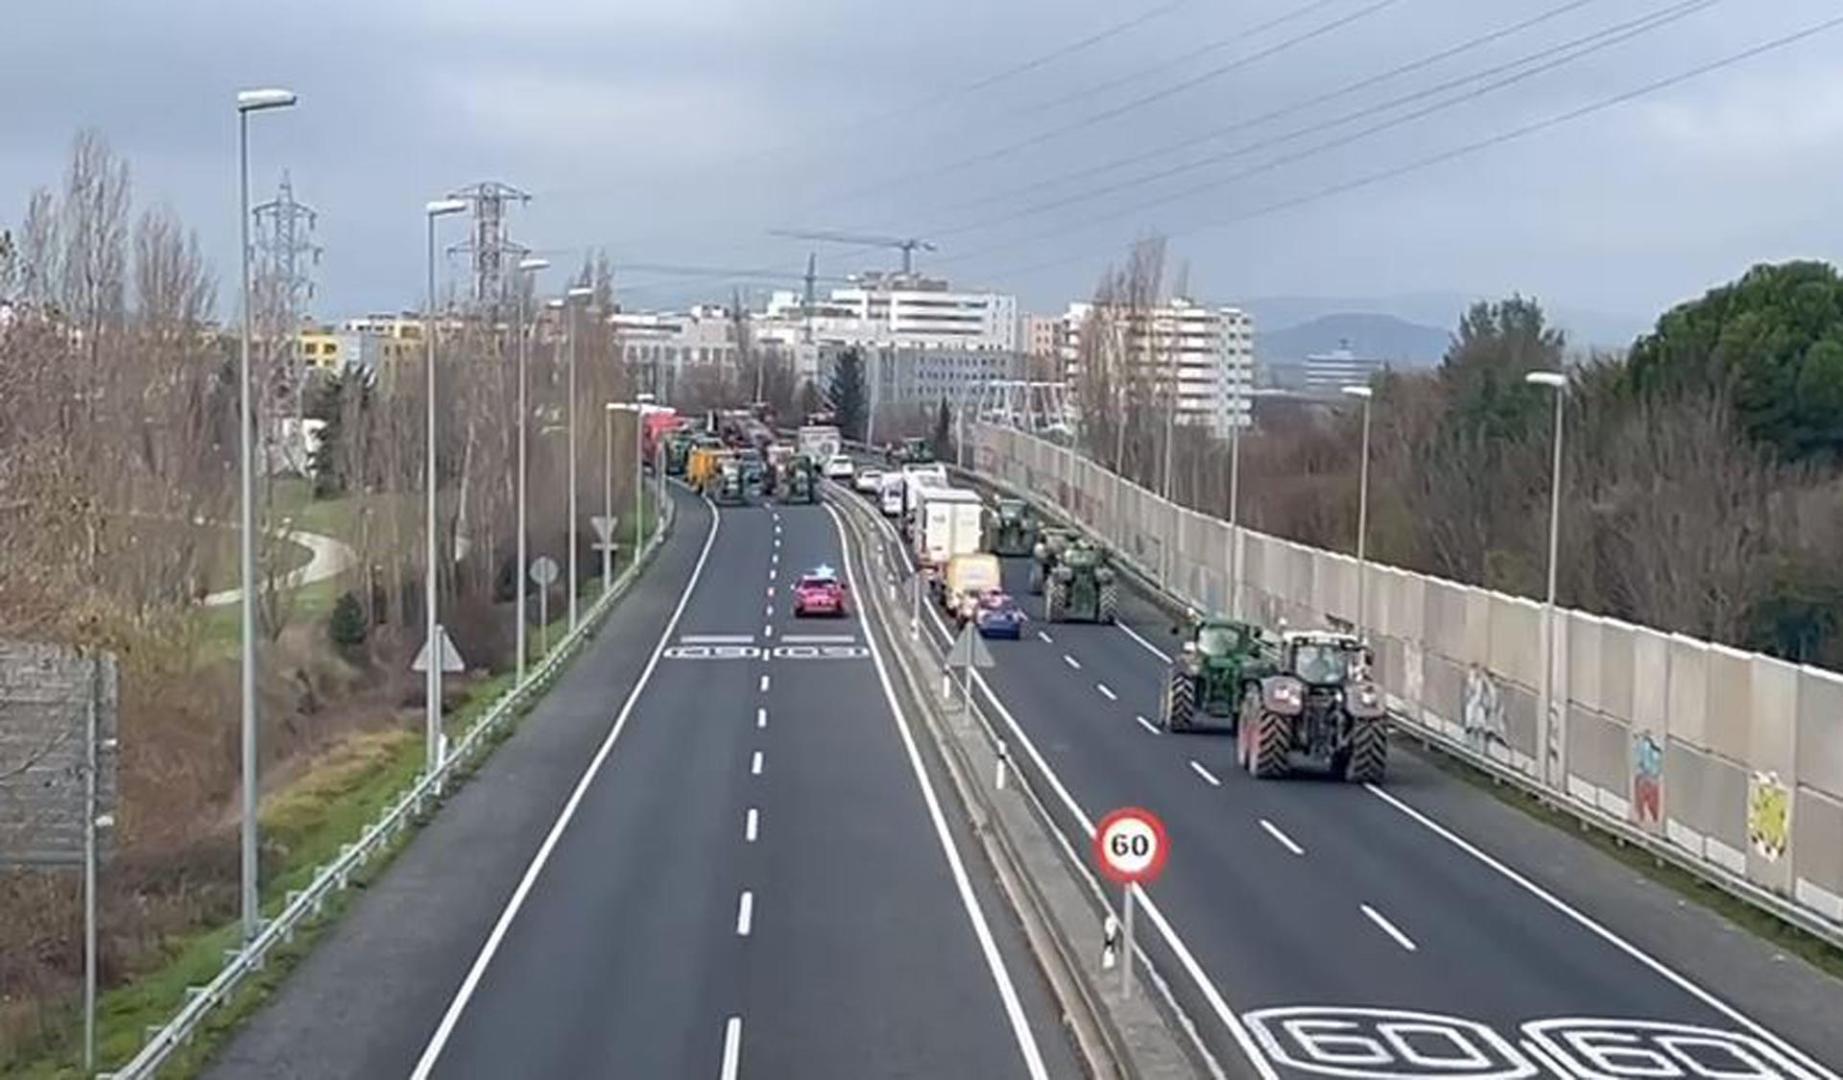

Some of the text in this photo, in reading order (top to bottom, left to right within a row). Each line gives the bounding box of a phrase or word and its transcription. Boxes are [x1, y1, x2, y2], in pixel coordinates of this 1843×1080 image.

[1111, 834, 1149, 857] 60
[1282, 1020, 1492, 1068] 60
[1562, 1031, 1774, 1078] 60
